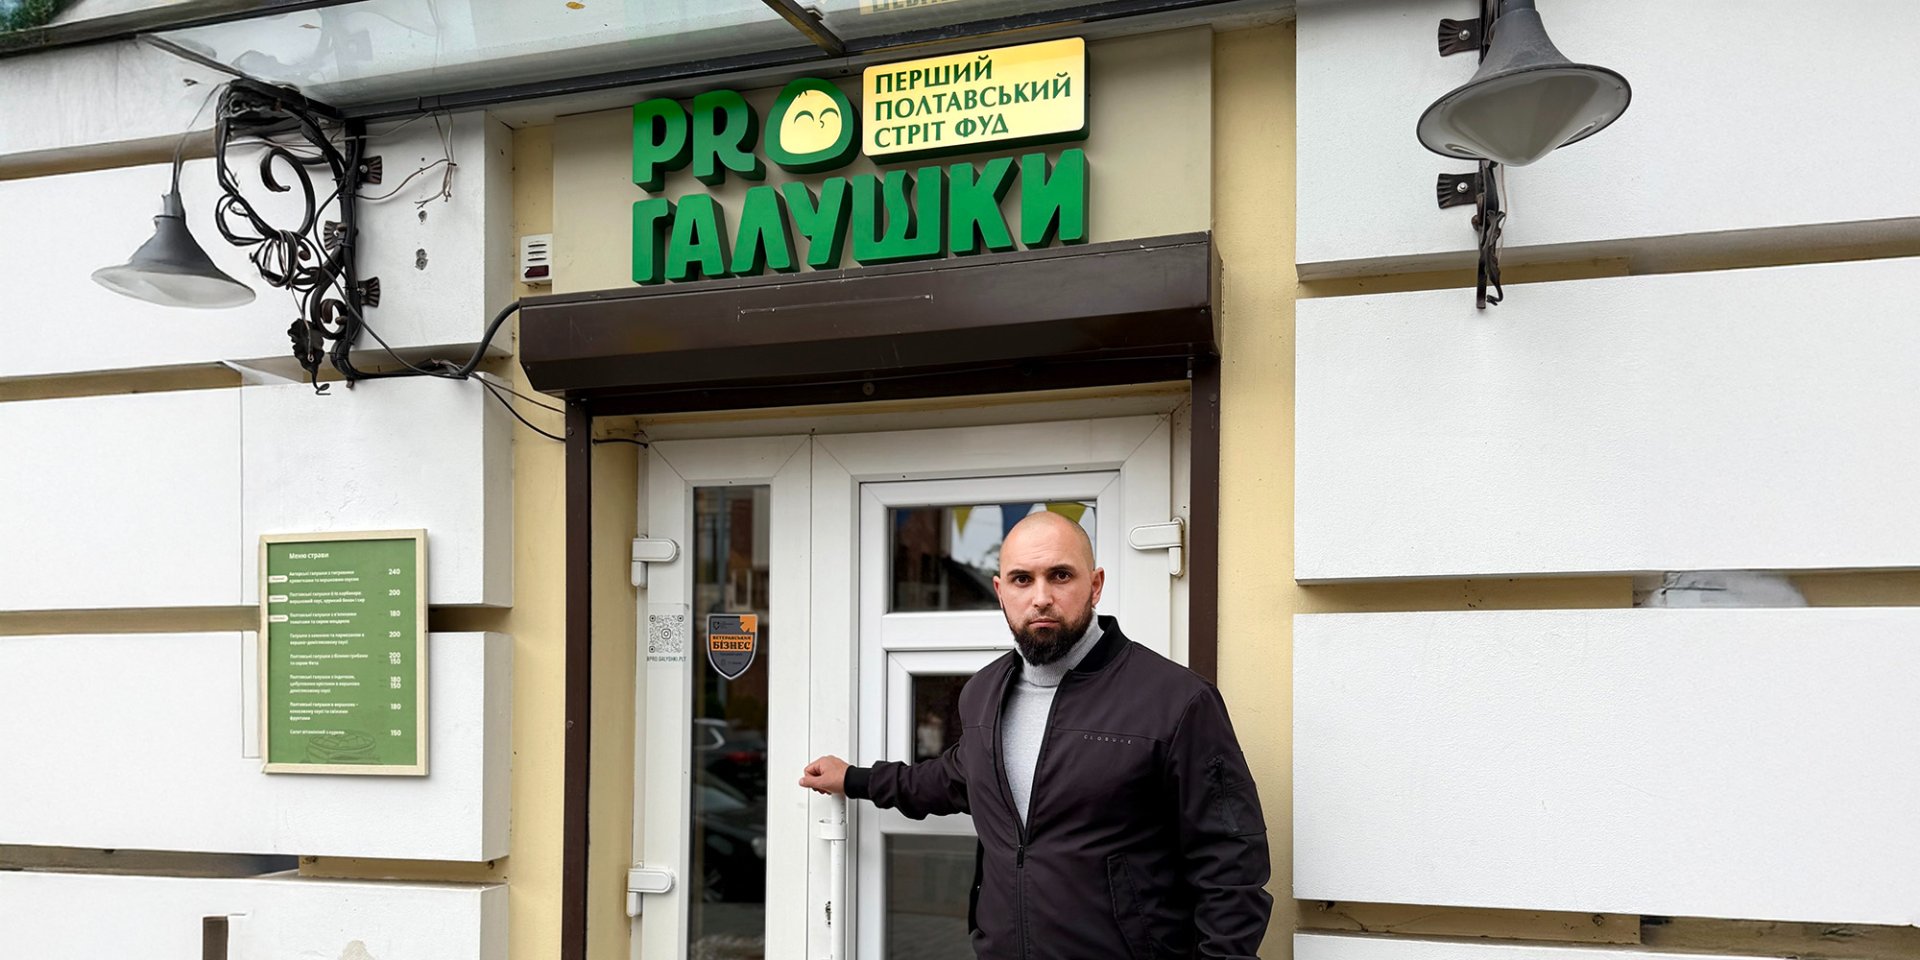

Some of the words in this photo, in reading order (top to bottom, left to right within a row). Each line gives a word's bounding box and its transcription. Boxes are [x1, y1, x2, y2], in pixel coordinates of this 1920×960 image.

[874, 55, 993, 95] ПЕРШИЙ
[874, 72, 1072, 121] ПОЛТАВСЬКИЙ
[874, 121, 943, 149] СТРІТ
[954, 113, 1010, 138] ФУД
[632, 148, 1090, 285] ГАЛУШКИ
[712, 641, 752, 650] БІЗНЕС
